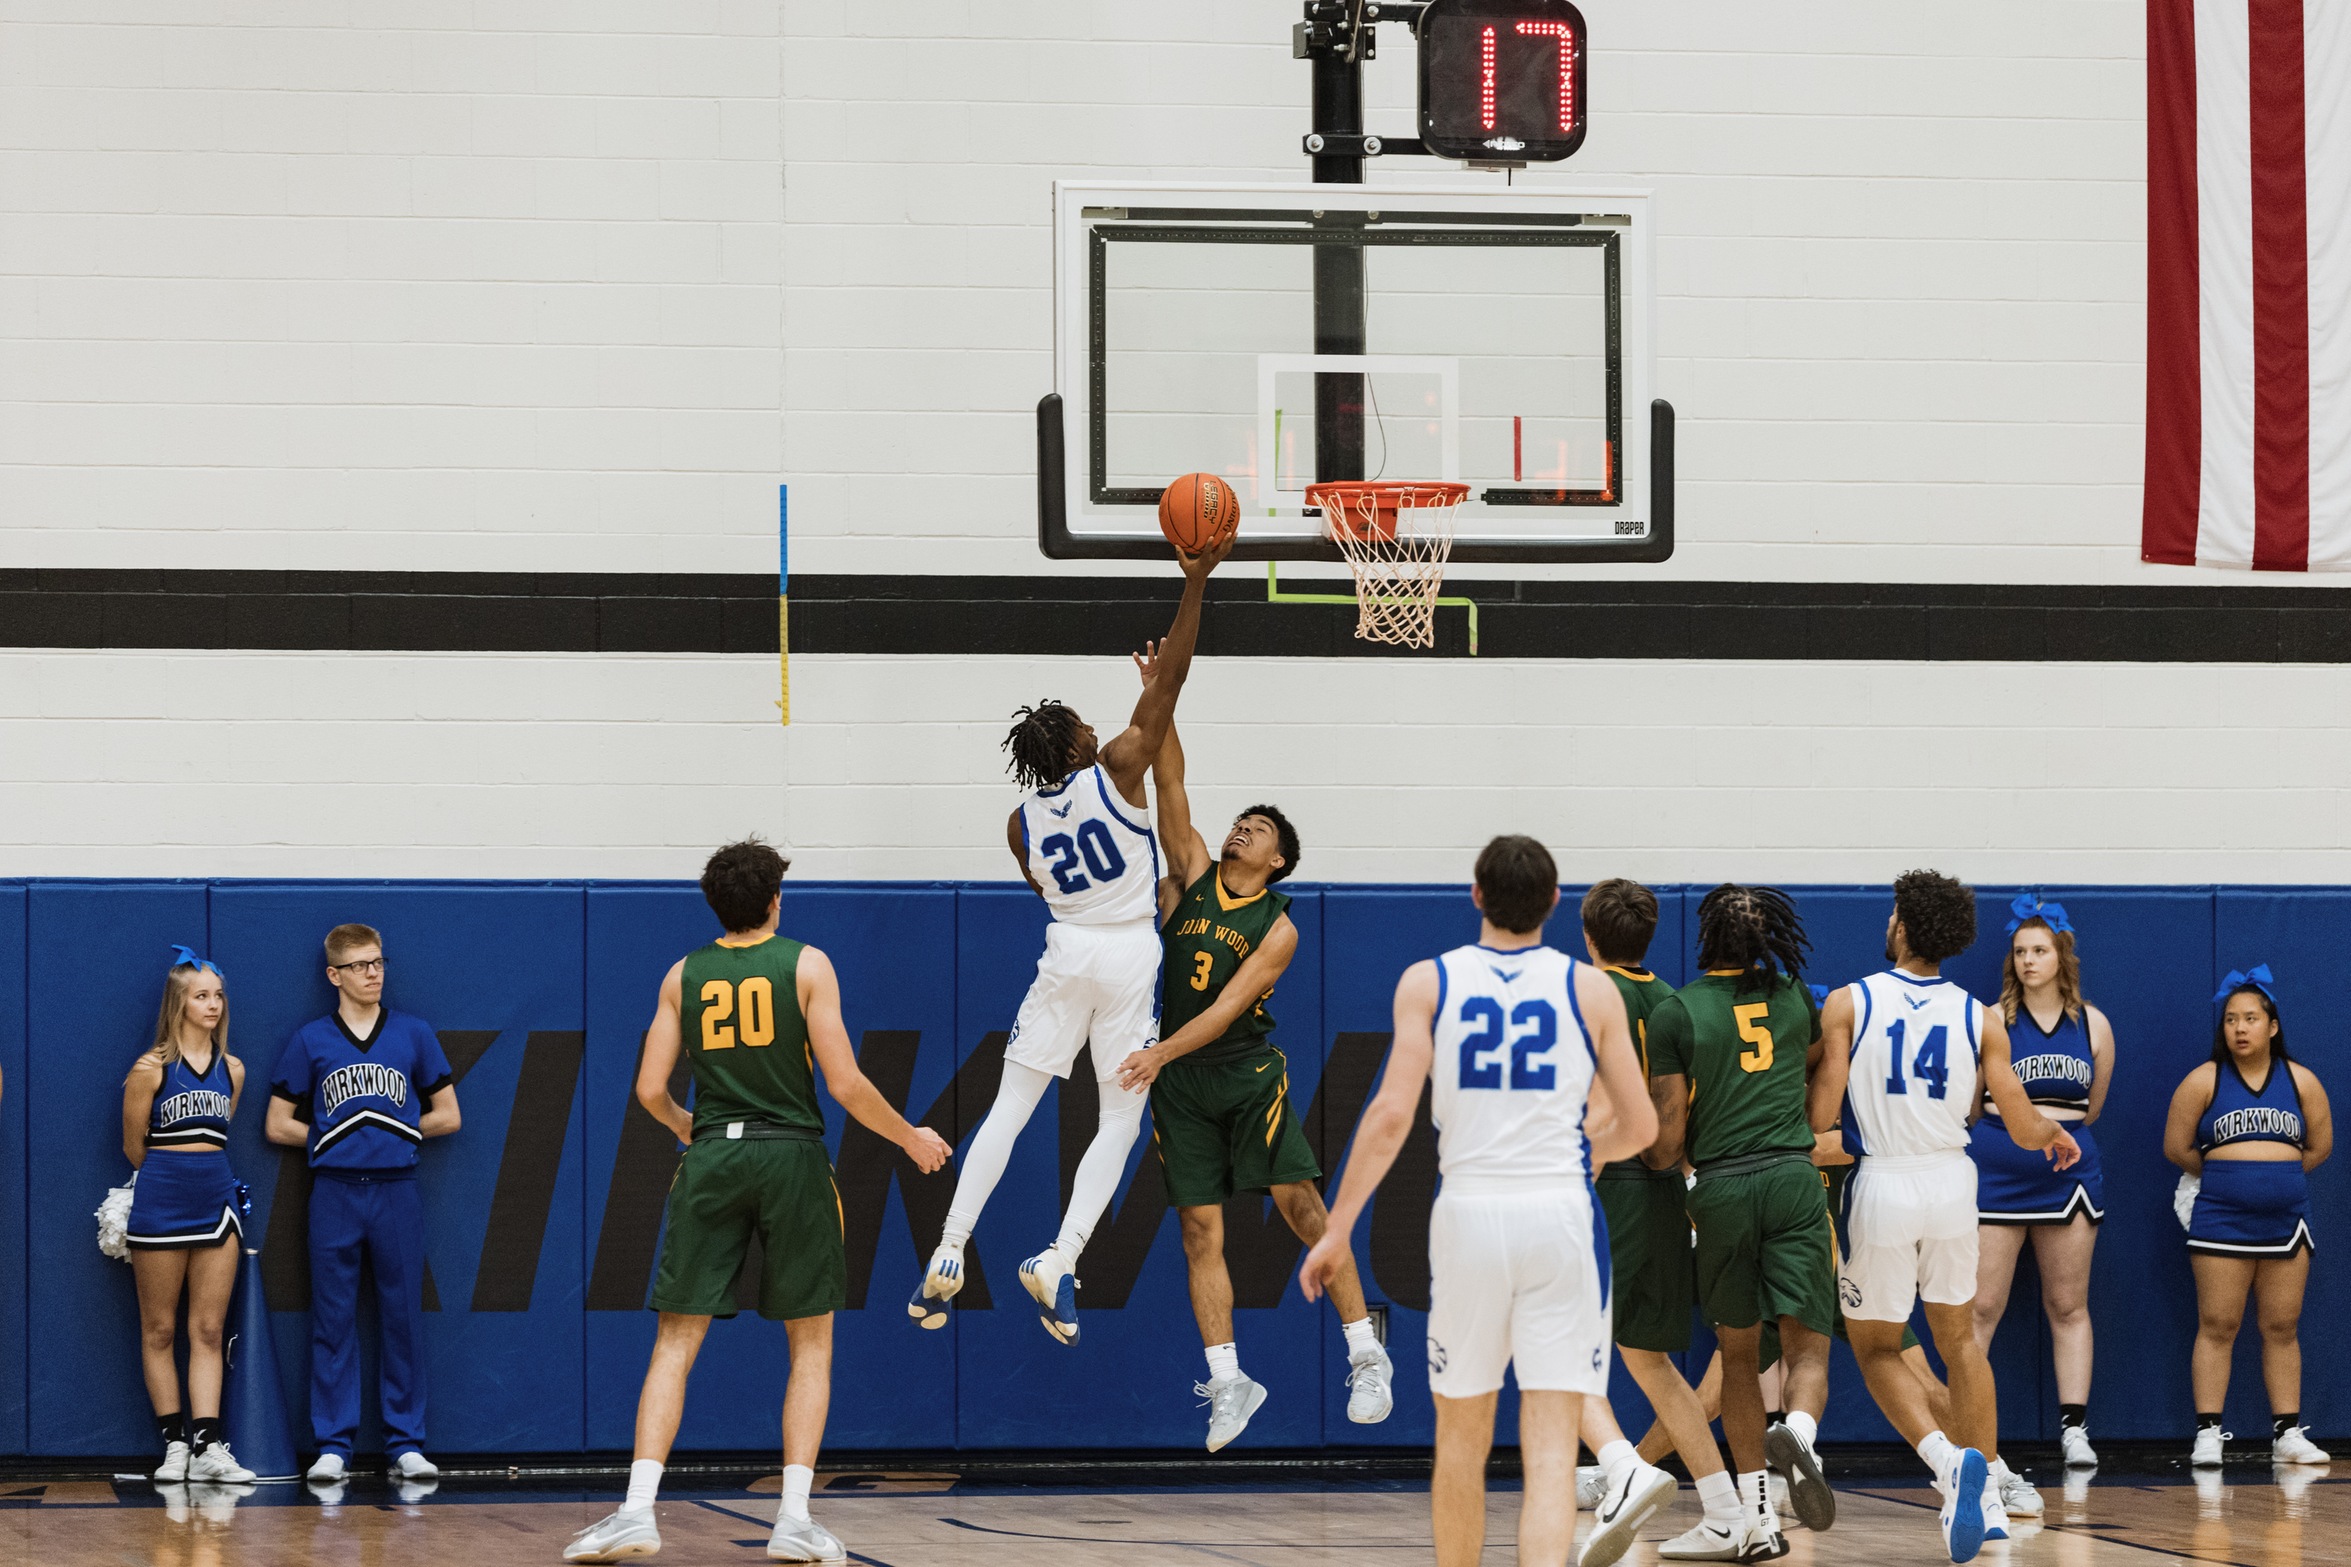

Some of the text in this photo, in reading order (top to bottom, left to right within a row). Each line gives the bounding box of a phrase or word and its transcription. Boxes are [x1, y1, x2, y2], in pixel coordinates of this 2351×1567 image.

[1482, 22, 1572, 132] 17
[1209, 480, 1219, 525] LEGACY
[1040, 817, 1127, 895] 20
[1189, 950, 1214, 992] 3
[700, 975, 776, 1051] 20
[1458, 996, 1558, 1091] 22
[1732, 1001, 1775, 1074] 5
[322, 1062, 407, 1118] KIRKWOOD
[1886, 1018, 1949, 1101] 14
[2213, 1107, 2301, 1144] KIRKWOOD
